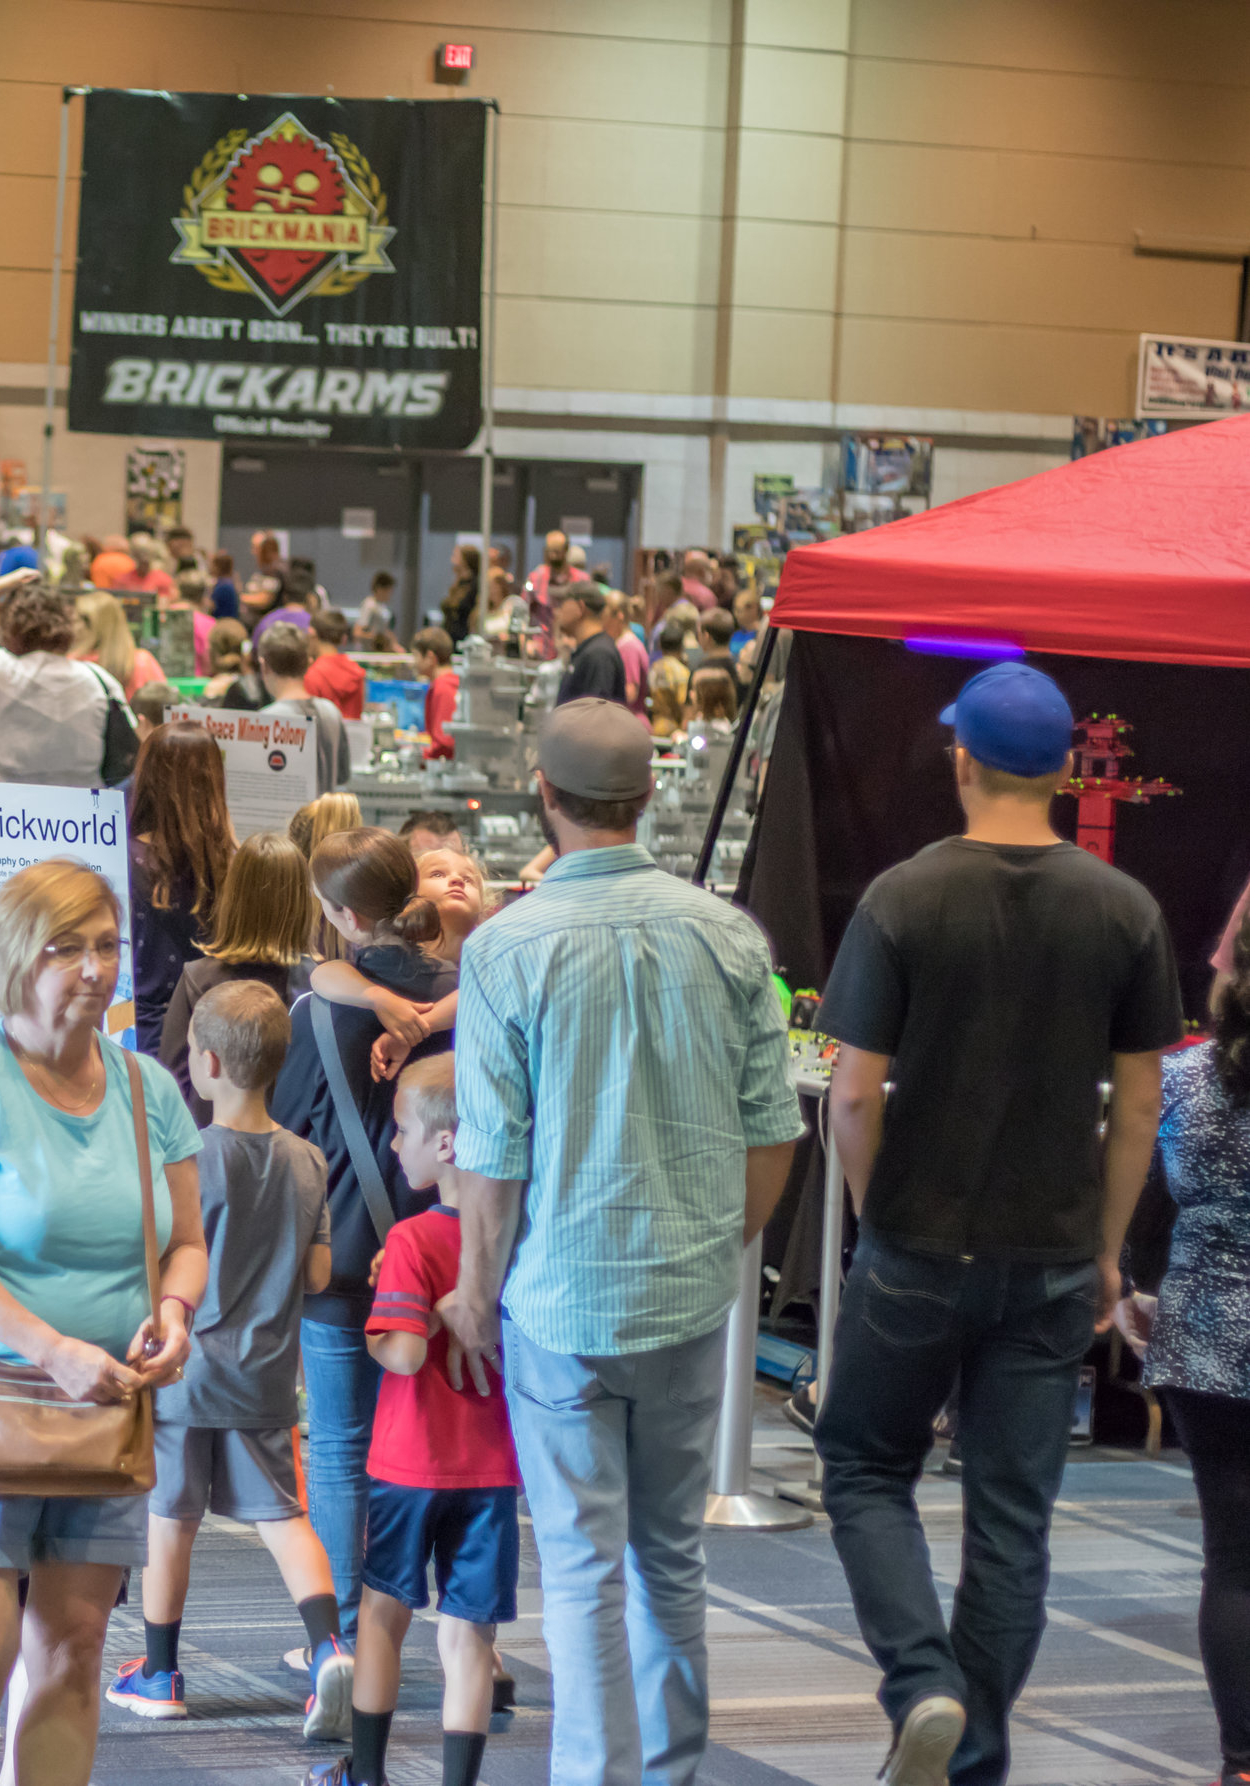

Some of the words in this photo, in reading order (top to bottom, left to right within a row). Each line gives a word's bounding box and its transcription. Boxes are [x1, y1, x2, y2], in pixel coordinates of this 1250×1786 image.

[207, 216, 362, 246] BRICKMANIA
[80, 311, 167, 338] WINNERS
[170, 315, 244, 340] AREN'T
[248, 319, 320, 344] BORN...
[325, 323, 410, 348] THEY'RE
[414, 326, 478, 349] BUILT!
[105, 357, 449, 417] BRICKARMS
[206, 714, 235, 741] Space
[238, 717, 270, 750] Mining
[273, 719, 307, 752] Colony
[18, 857, 31, 867] On
